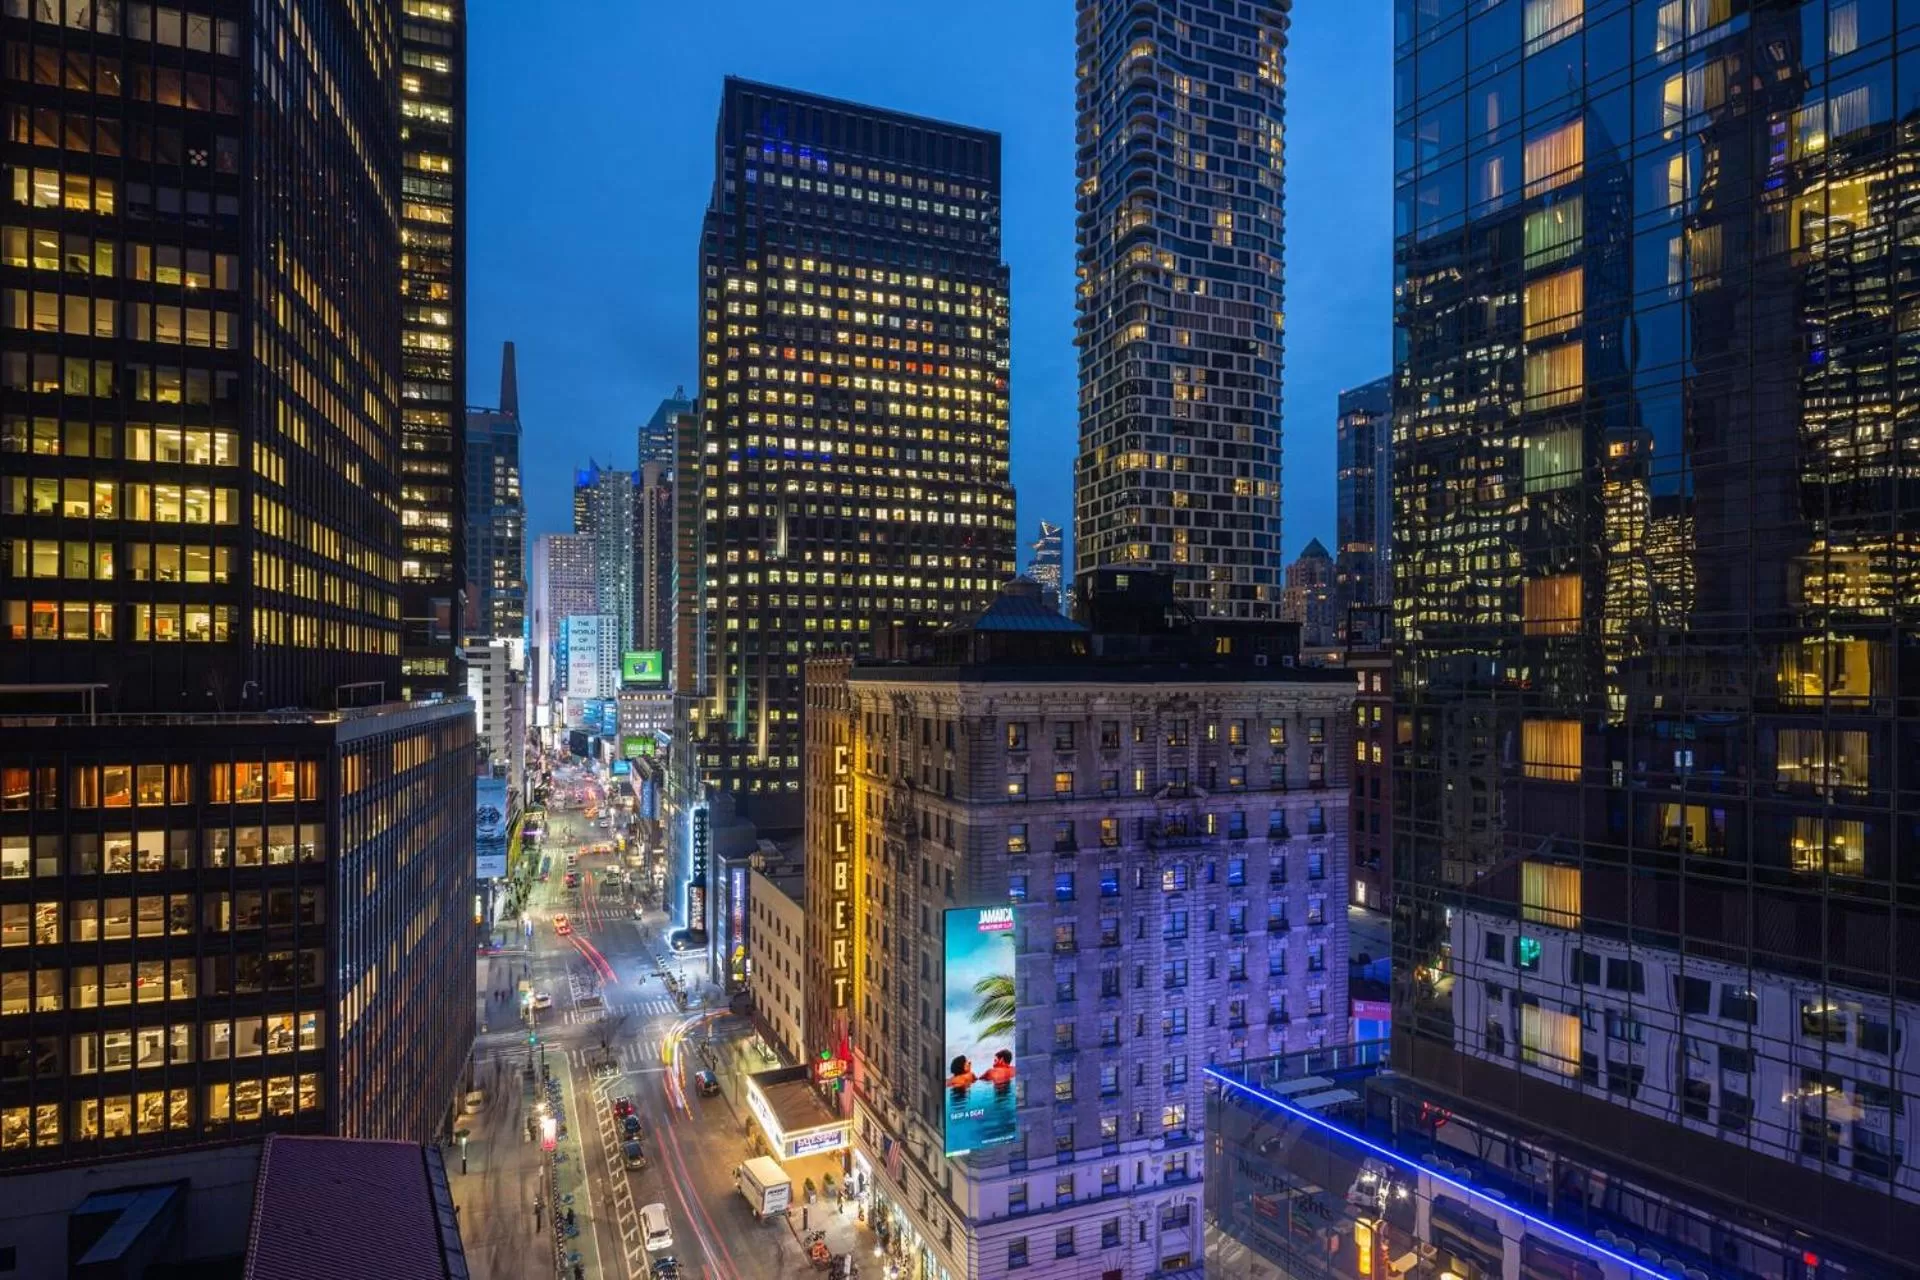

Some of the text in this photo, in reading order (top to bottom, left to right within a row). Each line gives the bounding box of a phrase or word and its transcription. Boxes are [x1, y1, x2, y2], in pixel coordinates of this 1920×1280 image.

[694, 816, 702, 877] BROADWAY
[834, 745, 848, 1008] COLBERT
[978, 907, 1014, 925] JAMAICA
